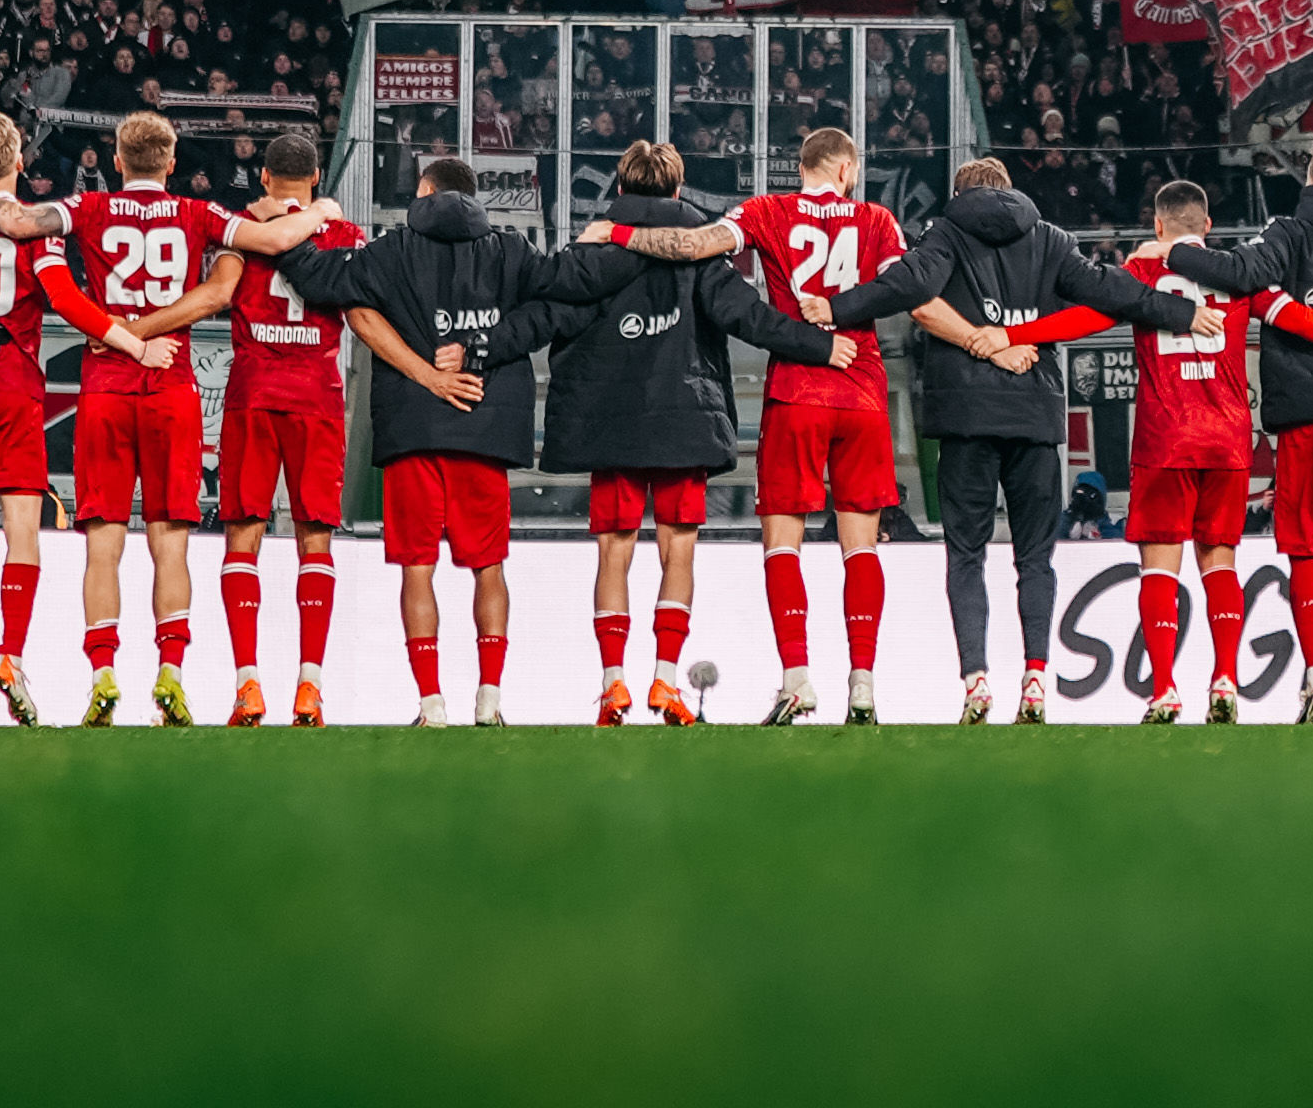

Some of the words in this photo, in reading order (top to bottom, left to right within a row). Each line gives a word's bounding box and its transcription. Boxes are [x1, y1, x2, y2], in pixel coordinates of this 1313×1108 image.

[380, 62, 454, 73] AMIGOS
[378, 76, 453, 87] SIEMPRE
[377, 90, 454, 101] FELICES
[109, 198, 179, 220] STUTTGART
[102, 226, 188, 307] 29
[789, 224, 860, 300] 24
[453, 308, 501, 331] JAKO
[645, 308, 681, 336] JAKO
[1003, 308, 1040, 326] JAK
[1103, 352, 1133, 367] DU
[1213, 612, 1241, 621] JAKO
[1057, 563, 1194, 699] SO
